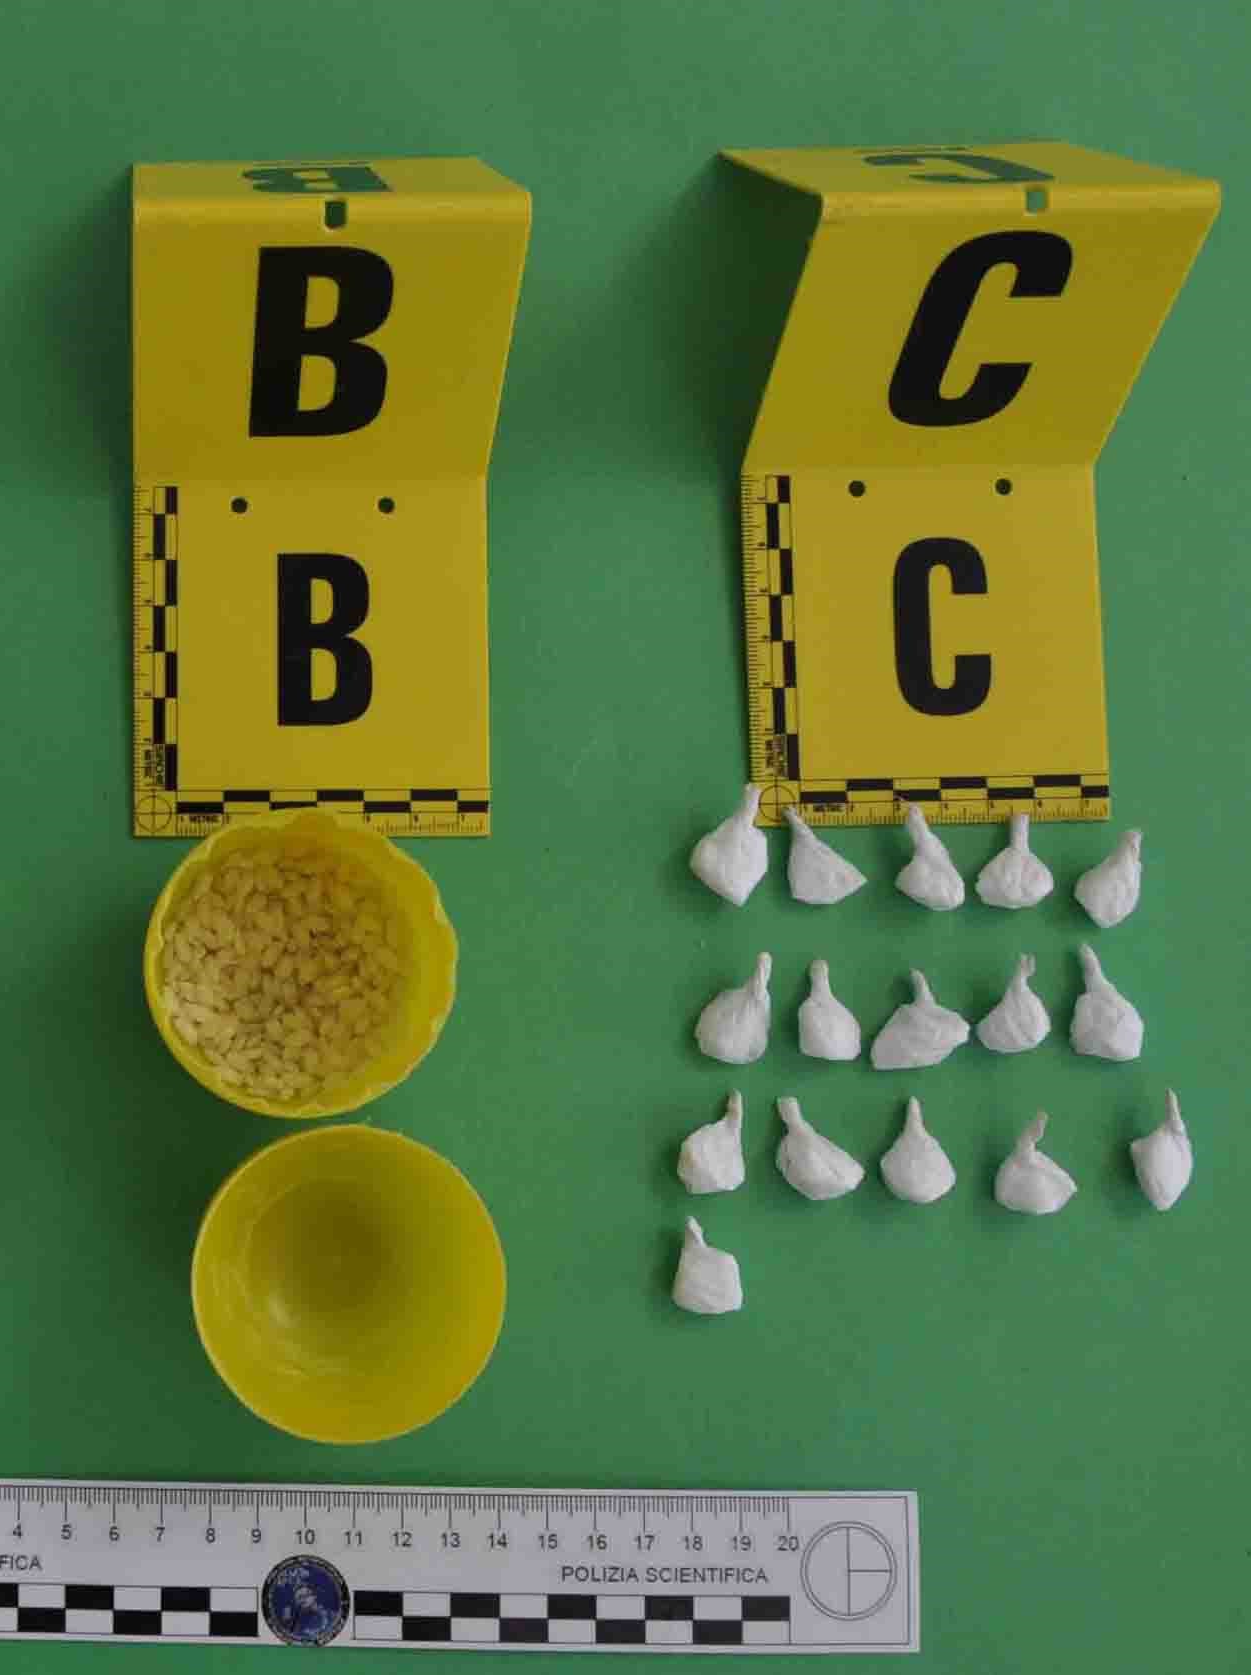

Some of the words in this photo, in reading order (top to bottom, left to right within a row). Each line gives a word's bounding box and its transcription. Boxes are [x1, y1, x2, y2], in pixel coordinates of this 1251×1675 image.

[248, 246, 394, 437] B
[888, 230, 1073, 427] C
[277, 553, 373, 726] B
[892, 537, 992, 716] C
[12, 1524, 24, 1538] 4
[61, 1525, 73, 1540] 5
[109, 1526, 120, 1542] 6
[156, 1527, 166, 1542] 7
[205, 1527, 216, 1543] 8
[251, 1528, 262, 1544] 9
[296, 1529, 316, 1545] 10
[345, 1530, 363, 1546] 11
[393, 1531, 412, 1547] 12
[441, 1532, 461, 1548] 13
[488, 1533, 509, 1549] 14
[538, 1534, 559, 1550] 15
[587, 1535, 608, 1551] 16
[637, 1535, 655, 1552] 17
[684, 1535, 703, 1552] 18
[732, 1535, 752, 1552] 19
[777, 1535, 800, 1552] 20
[561, 1565, 639, 1583] POLIZIA
[645, 1567, 769, 1585] SCIENTIFICA
